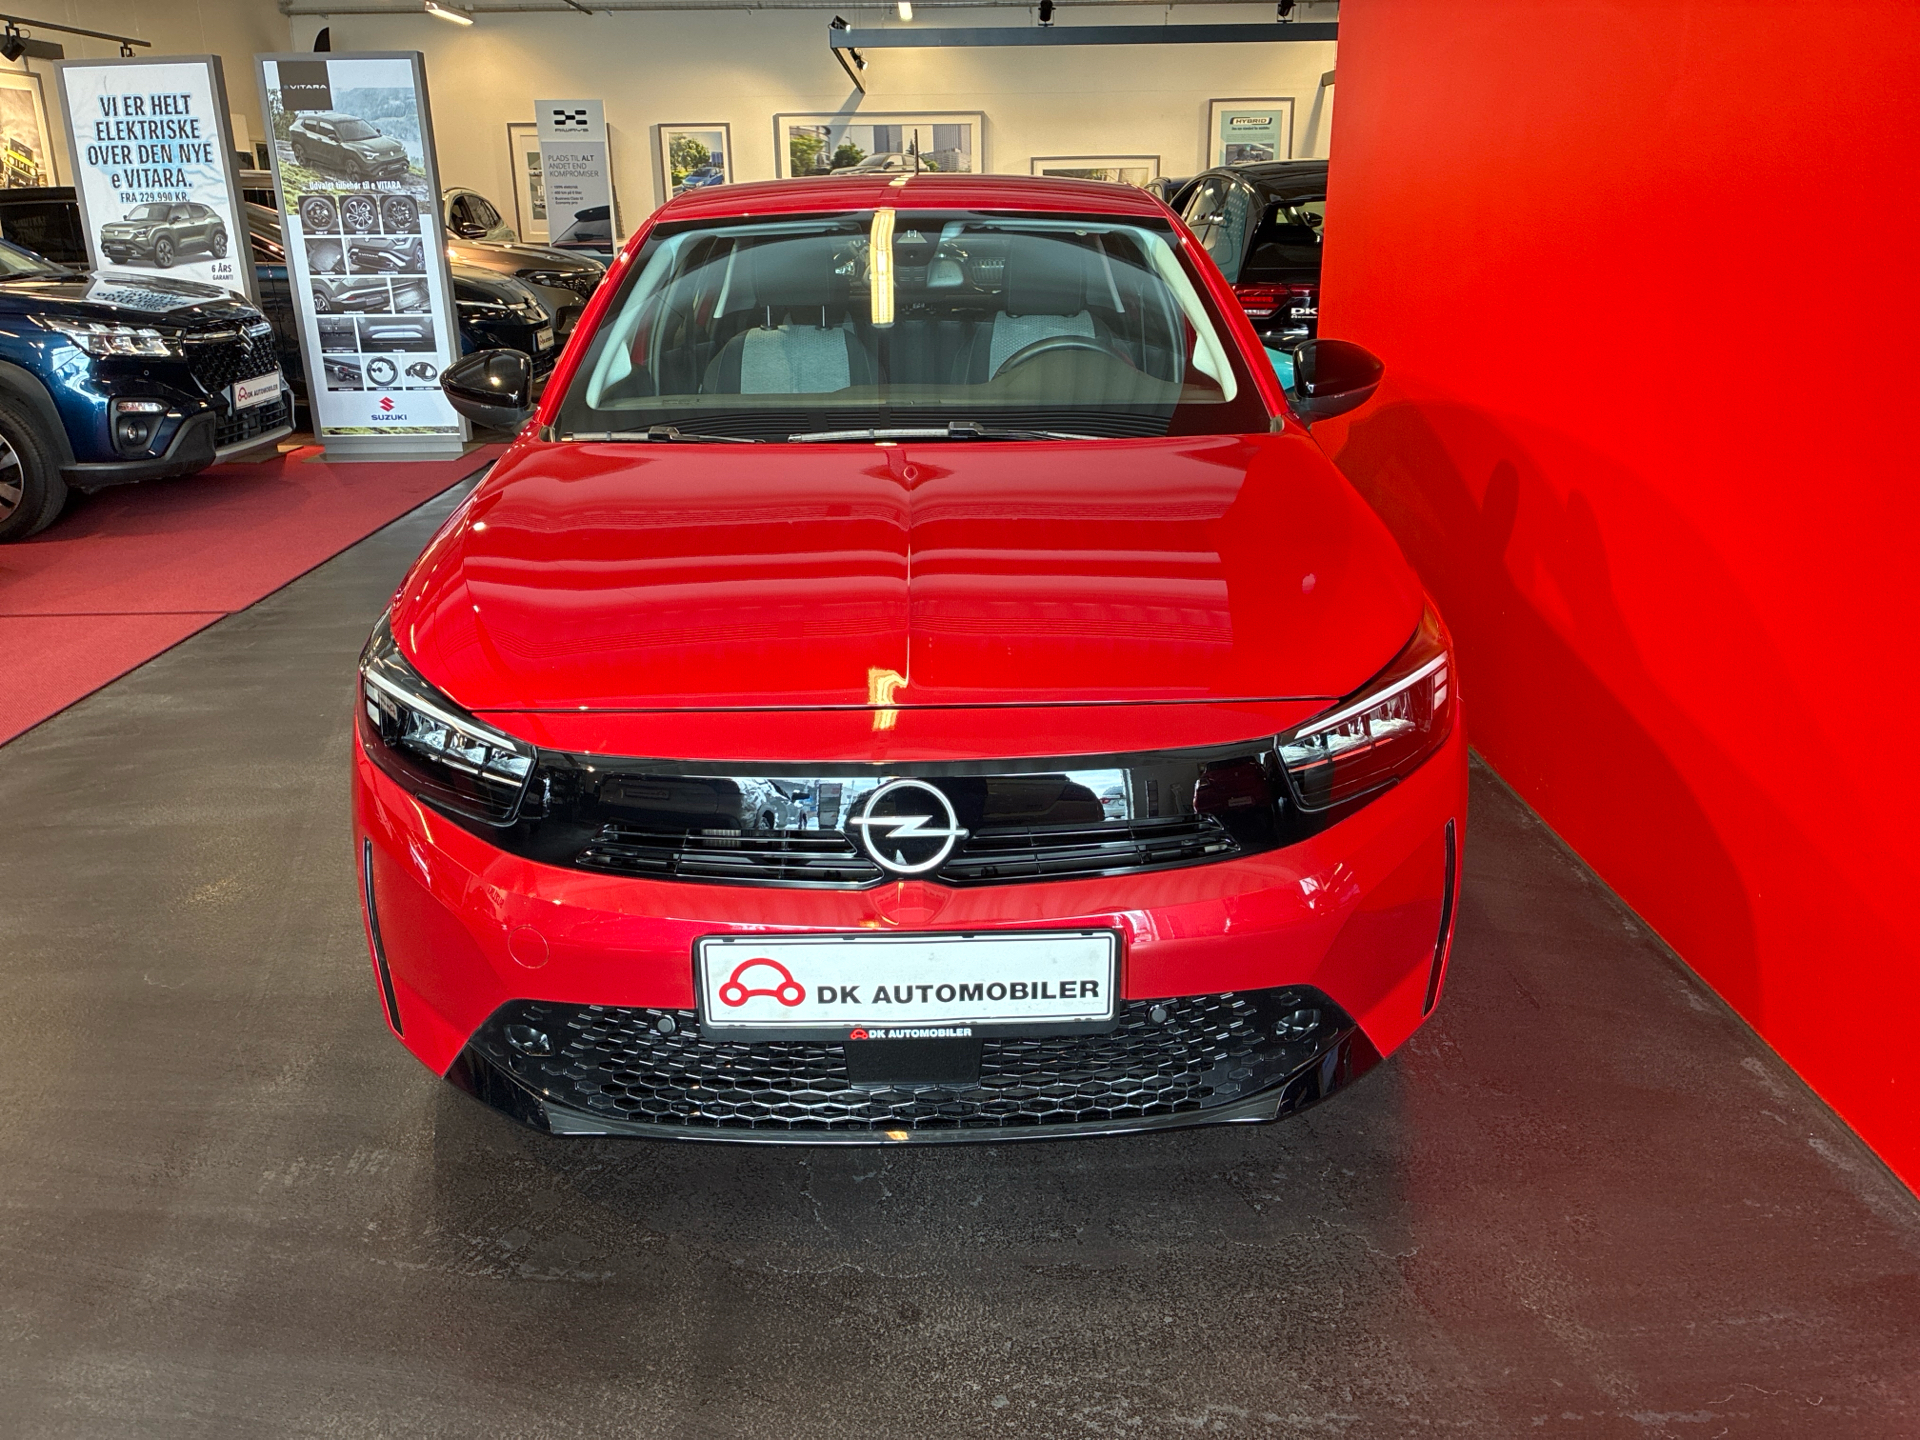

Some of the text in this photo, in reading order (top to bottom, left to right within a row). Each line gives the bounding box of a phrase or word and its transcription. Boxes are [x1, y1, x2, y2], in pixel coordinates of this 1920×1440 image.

[100, 94, 190, 116] VI ER HELT
[96, 119, 200, 141] ELEKTRISKE
[88, 143, 213, 166] OVER DEN NYE
[112, 168, 193, 188] e VITARA.
[376, 181, 401, 189] VITARA
[120, 192, 138, 203] FRA
[140, 192, 173, 202] 229.990
[212, 262, 232, 273] 6 ÅRS
[816, 980, 1100, 1004] DK AUTOMOBILER
[868, 1028, 972, 1038] DK AUTOMOBILER
